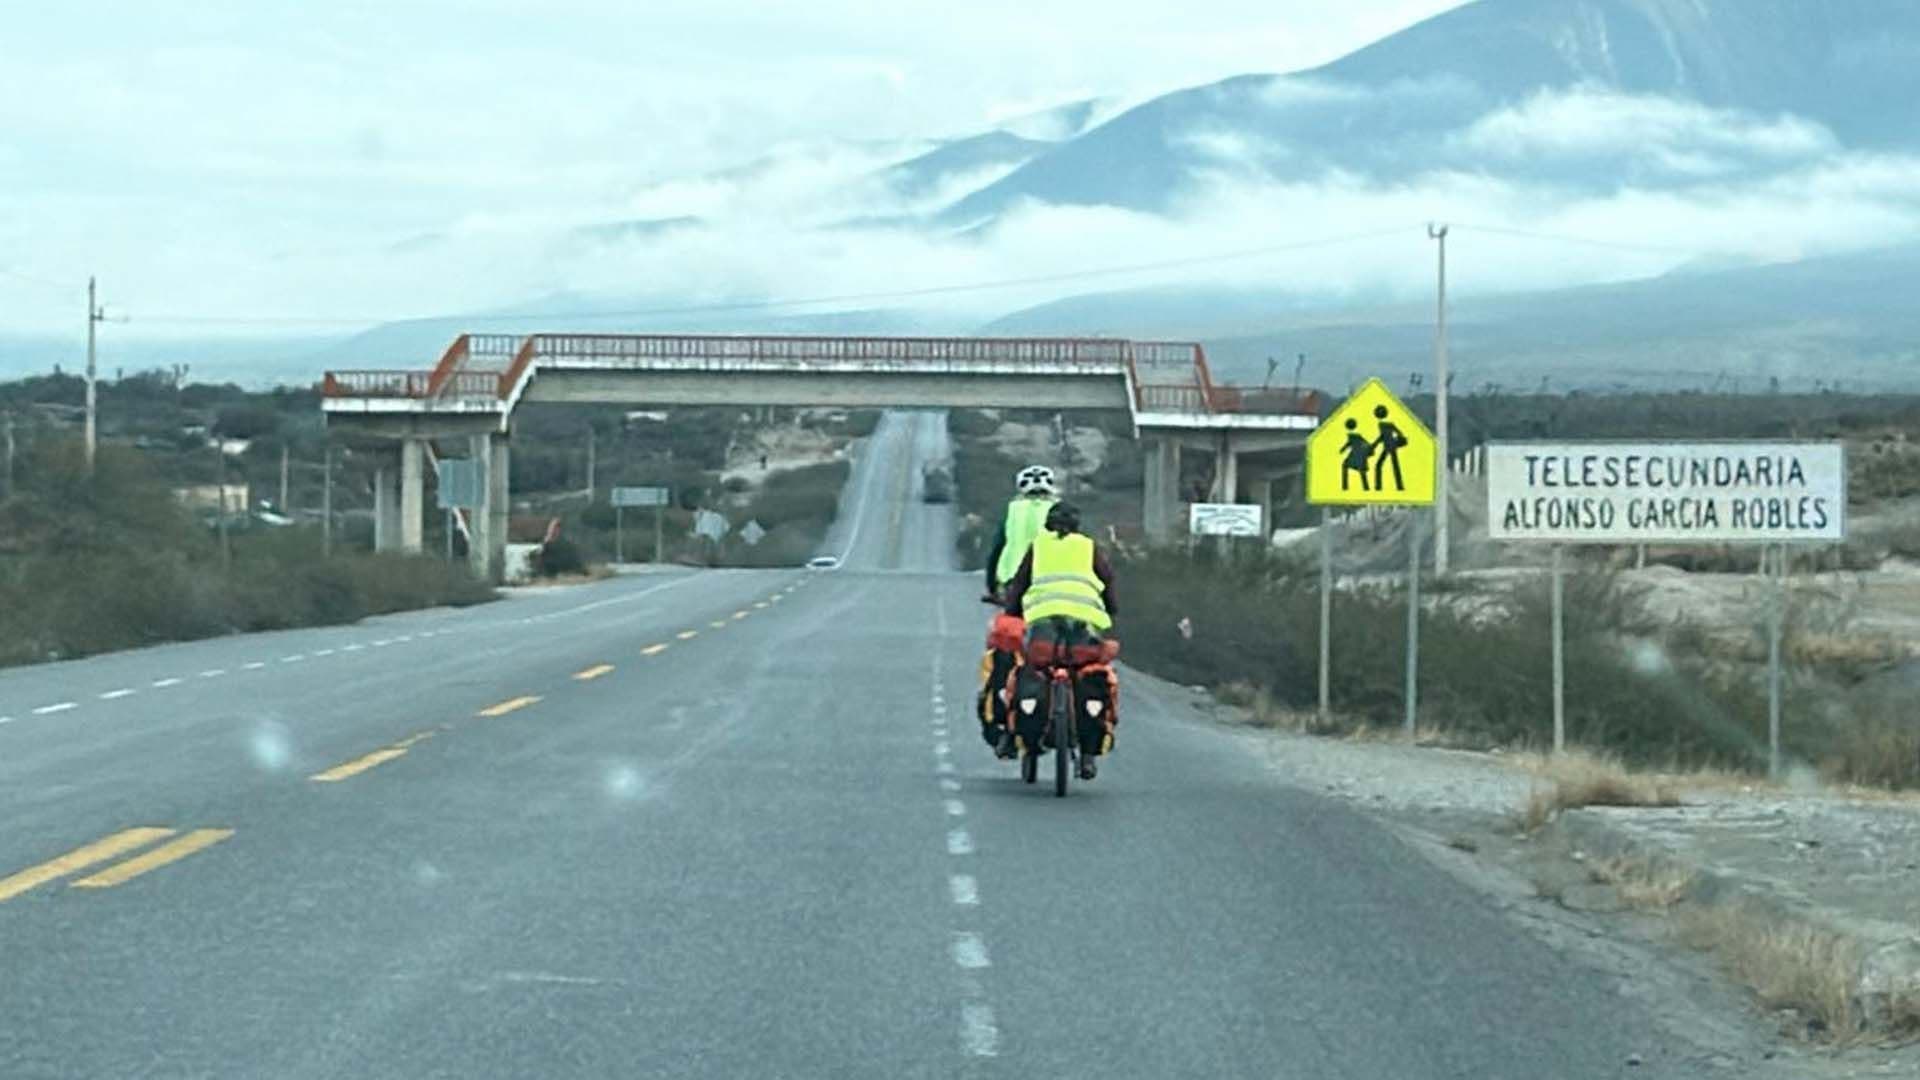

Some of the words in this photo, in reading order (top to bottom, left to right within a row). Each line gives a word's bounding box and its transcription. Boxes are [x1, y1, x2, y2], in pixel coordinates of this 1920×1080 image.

[1525, 456, 1806, 487] TELESECUNDARIA
[1503, 497, 1614, 529] ALFONSO
[1628, 497, 1719, 529] GARCIA
[1732, 497, 1827, 529] ROBLES
